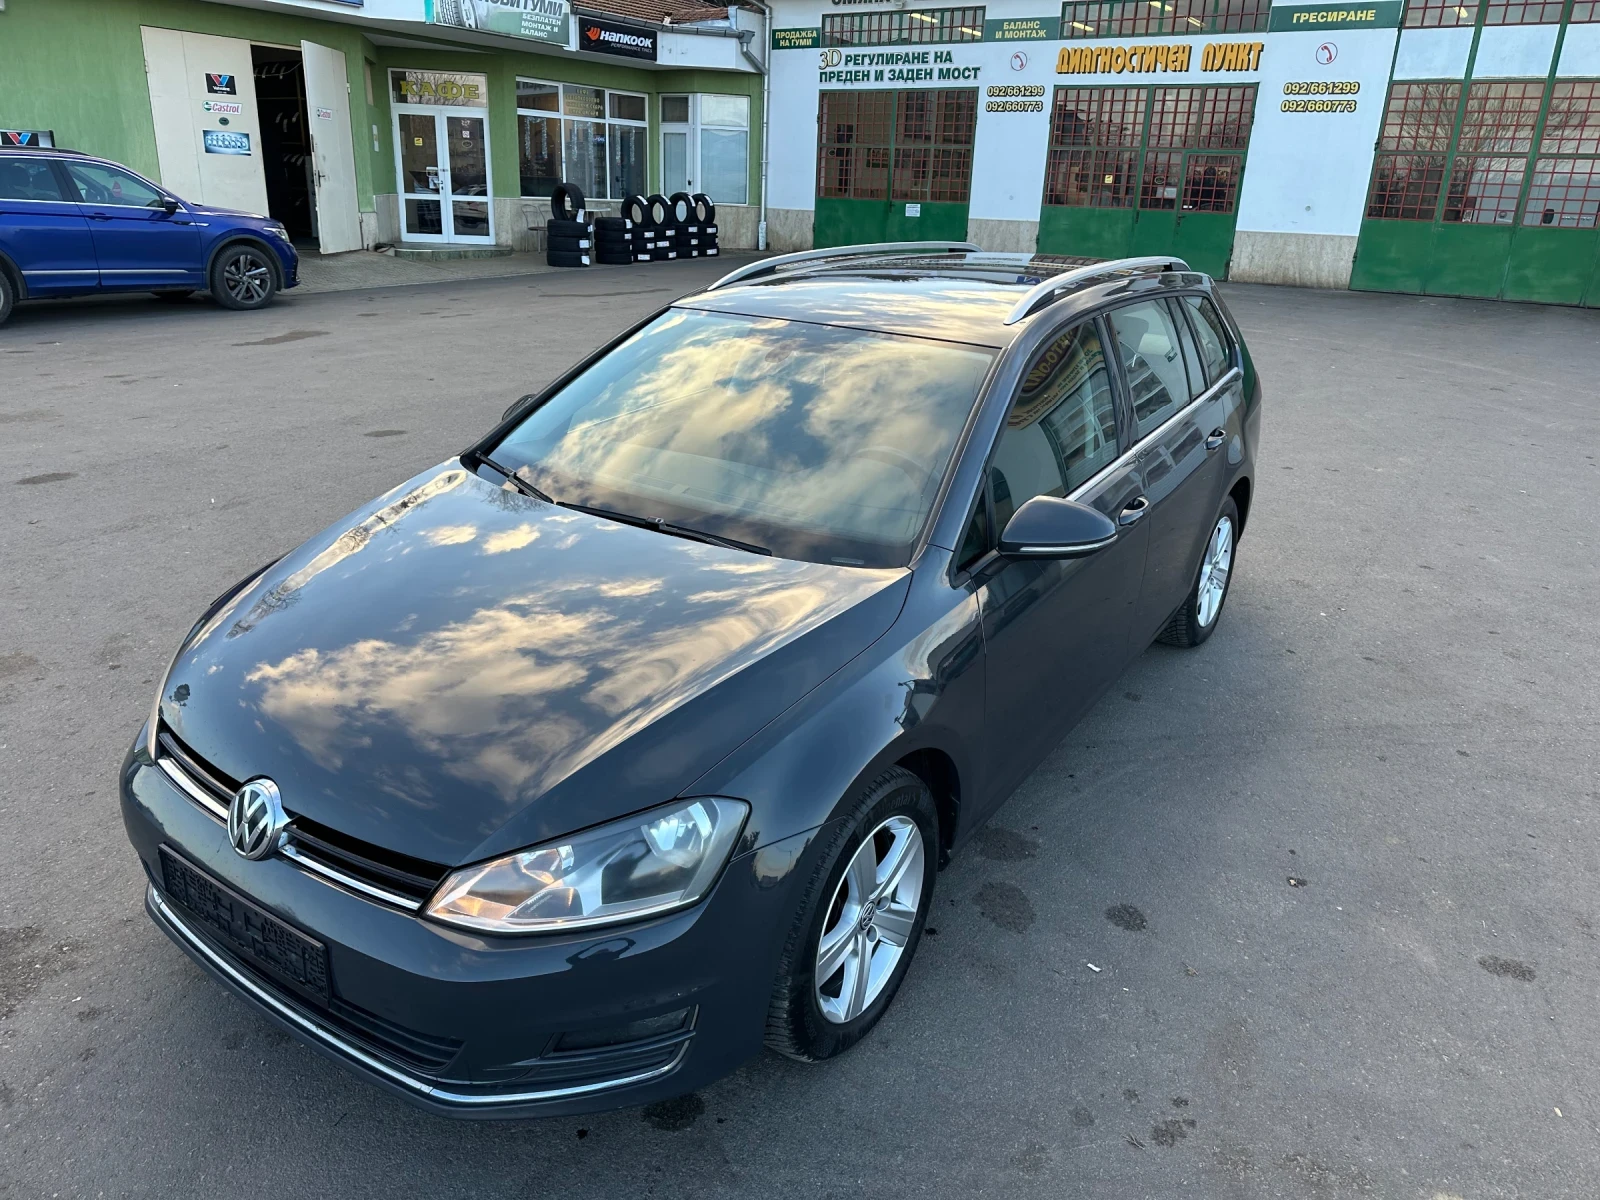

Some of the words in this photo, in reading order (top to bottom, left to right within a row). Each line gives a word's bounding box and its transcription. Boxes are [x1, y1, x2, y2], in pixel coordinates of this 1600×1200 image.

[522, 13, 561, 26] БЕЗПЛАТЕН
[1292, 9, 1376, 23] ГРЕСИРАНЕ
[521, 21, 552, 32] МОНТАЖ
[1003, 20, 1040, 29] БАЛАНС
[521, 28, 548, 38] БАЛАНС
[775, 30, 817, 39] ПРОДАЖБА
[1004, 29, 1047, 38] МОНТАЖ
[779, 39, 789, 47] НА
[791, 38, 812, 46] ГУМИ
[818, 49, 842, 70] 3D
[844, 51, 930, 66] РЕГУЛИРАНЕ
[934, 50, 954, 64] НА
[1056, 45, 1192, 75] ДИАГНОСТИЧЕН
[1201, 41, 1265, 73] ПУНКТ
[819, 69, 871, 84] ПРЕДЕН
[874, 69, 884, 82] И
[888, 68, 933, 83] ЗАДЕН
[938, 65, 981, 80] МОСТ
[400, 80, 480, 100] КАФЕ
[986, 85, 1045, 97] 092/661299
[1283, 81, 1360, 96] 092/661299
[212, 103, 240, 113] Castrol
[985, 100, 1044, 112] 092/660773
[1280, 100, 1357, 113] 092/660773
